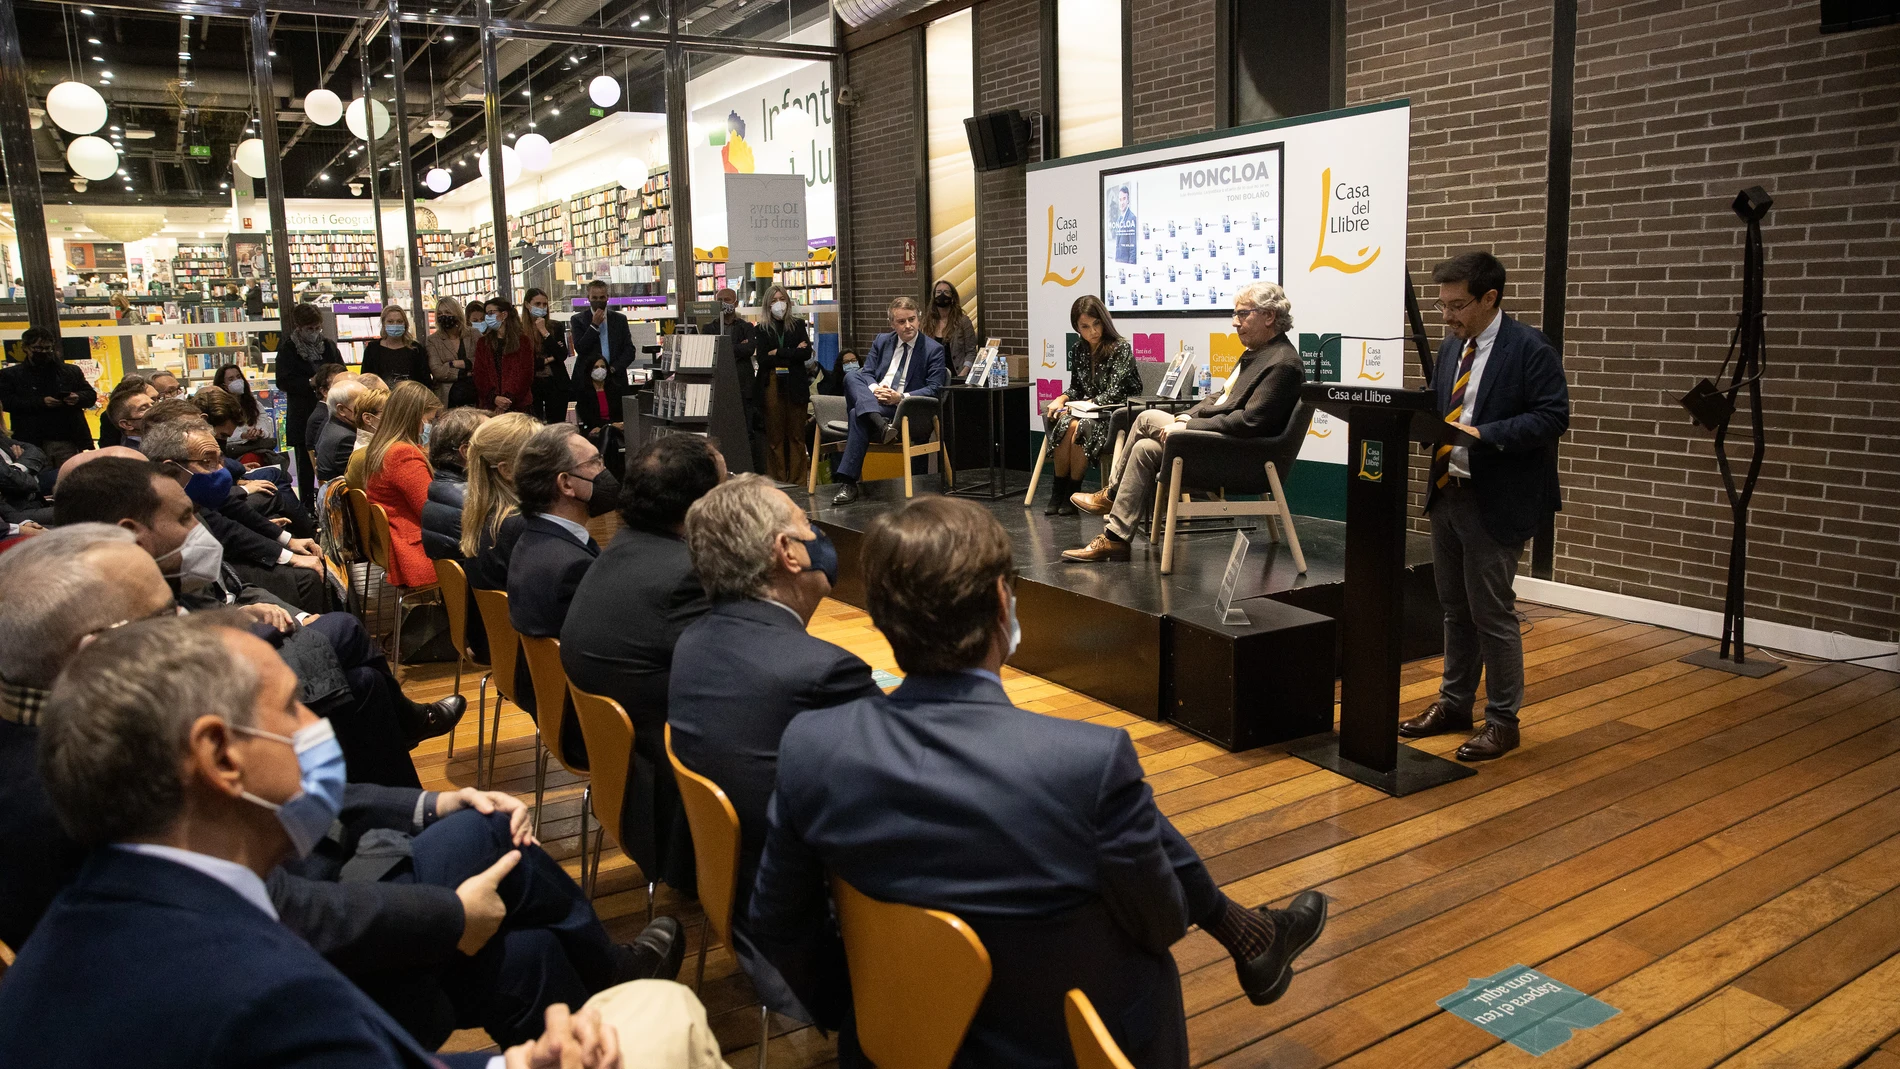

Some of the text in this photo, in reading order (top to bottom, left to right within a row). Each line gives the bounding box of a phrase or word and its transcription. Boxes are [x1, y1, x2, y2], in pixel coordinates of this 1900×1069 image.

[1179, 161, 1269, 190] MONCLOA
[1227, 194, 1242, 202] TONI
[1243, 190, 1270, 200] BOLAÑO
[1335, 183, 1370, 200] Casa
[1352, 200, 1370, 215] del
[1056, 216, 1078, 230] Casa
[1331, 215, 1370, 234] Llibre
[1066, 230, 1078, 242] del
[1053, 242, 1078, 256] Llibre
[1212, 353, 1237, 362] Gràcies
[1212, 365, 1223, 374] per
[1327, 387, 1391, 404] Casa del Llibre
[1365, 459, 1379, 467] Llibre
[1509, 972, 1539, 989] torn
[1473, 981, 1563, 1025] Espera el teu
